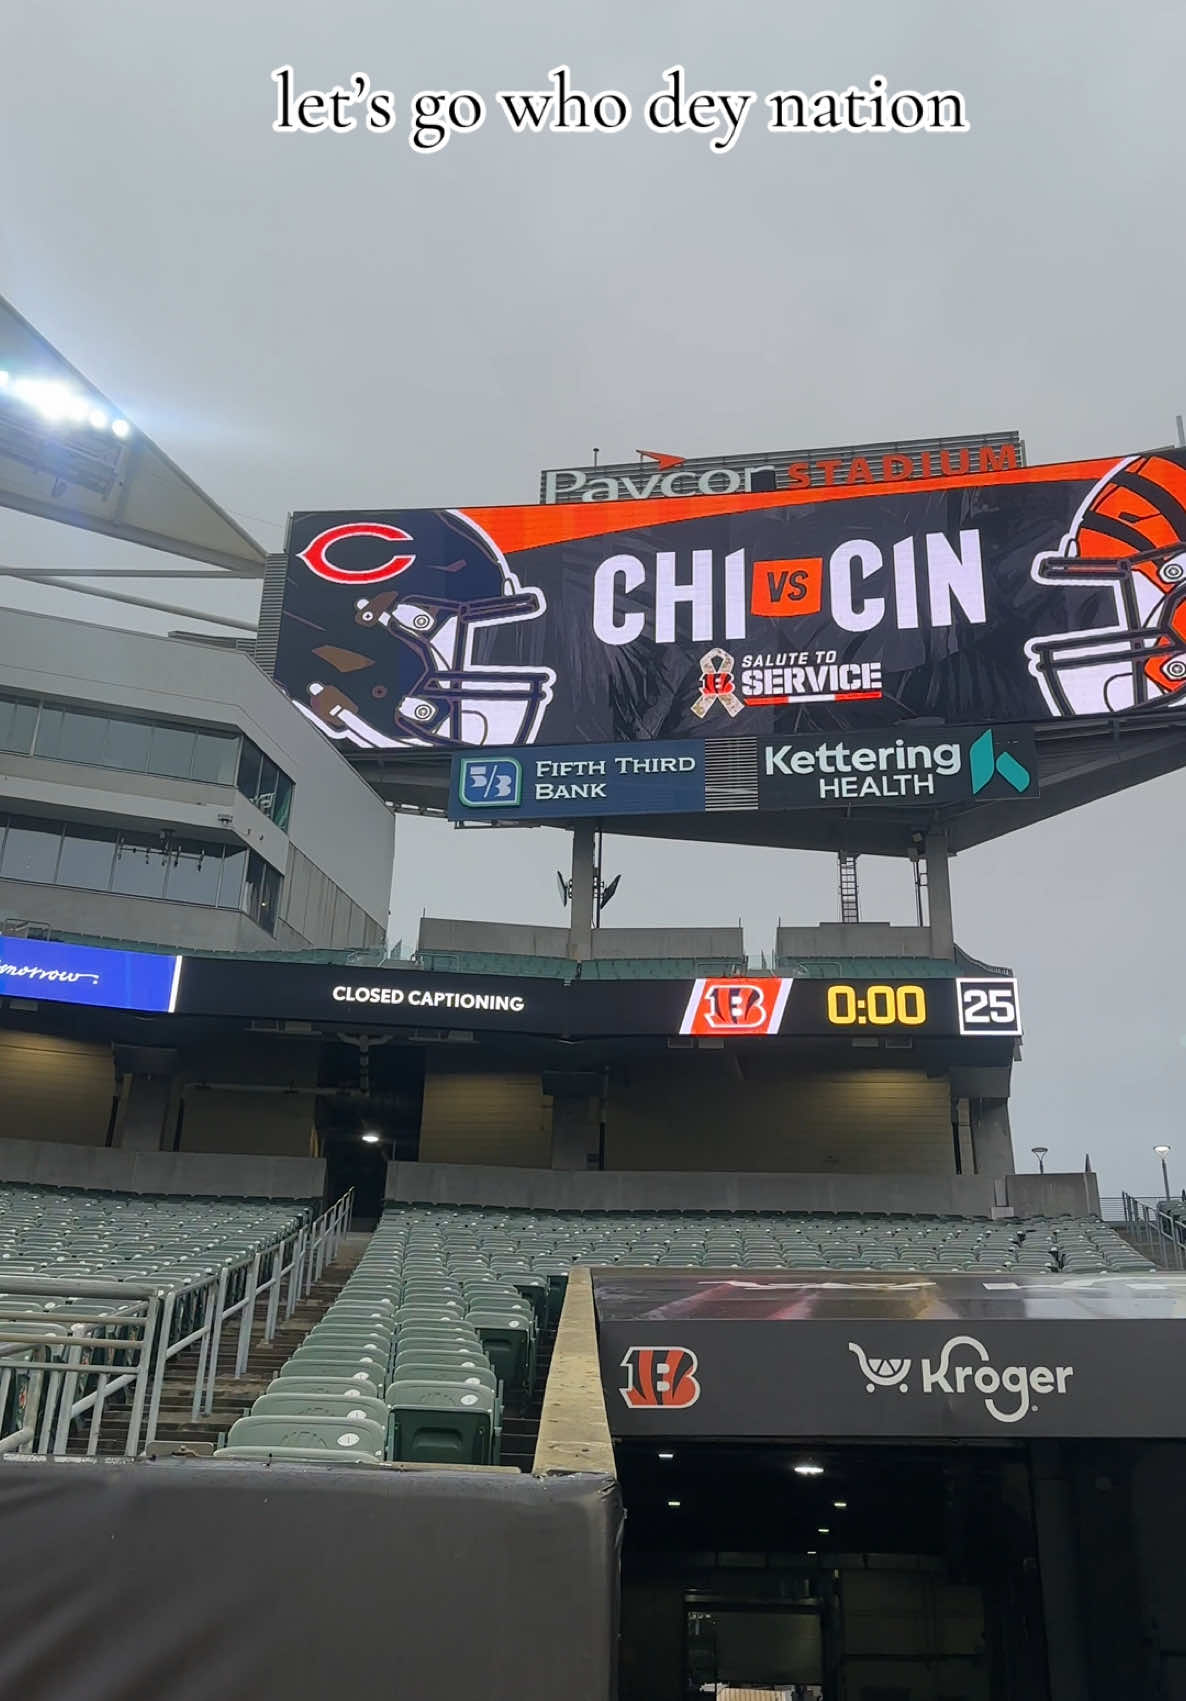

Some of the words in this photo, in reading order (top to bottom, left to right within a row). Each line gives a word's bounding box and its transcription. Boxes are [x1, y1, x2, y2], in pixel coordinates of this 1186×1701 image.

[787, 443, 1018, 489] STADIUM
[593, 547, 746, 646] CHI
[766, 570, 809, 603] VS
[829, 529, 987, 632] CIN
[741, 651, 809, 668] SALUTE
[815, 650, 837, 664] TO
[741, 662, 883, 696] SERVICE
[765, 739, 962, 776] Kettering
[819, 773, 935, 799] HEALTH
[332, 985, 405, 1005] CLOSED
[408, 989, 526, 1012] CAPTIONING
[827, 984, 927, 1026] 0:00
[963, 989, 1016, 1024] 25
[920, 1335, 1074, 1423] Kroger
